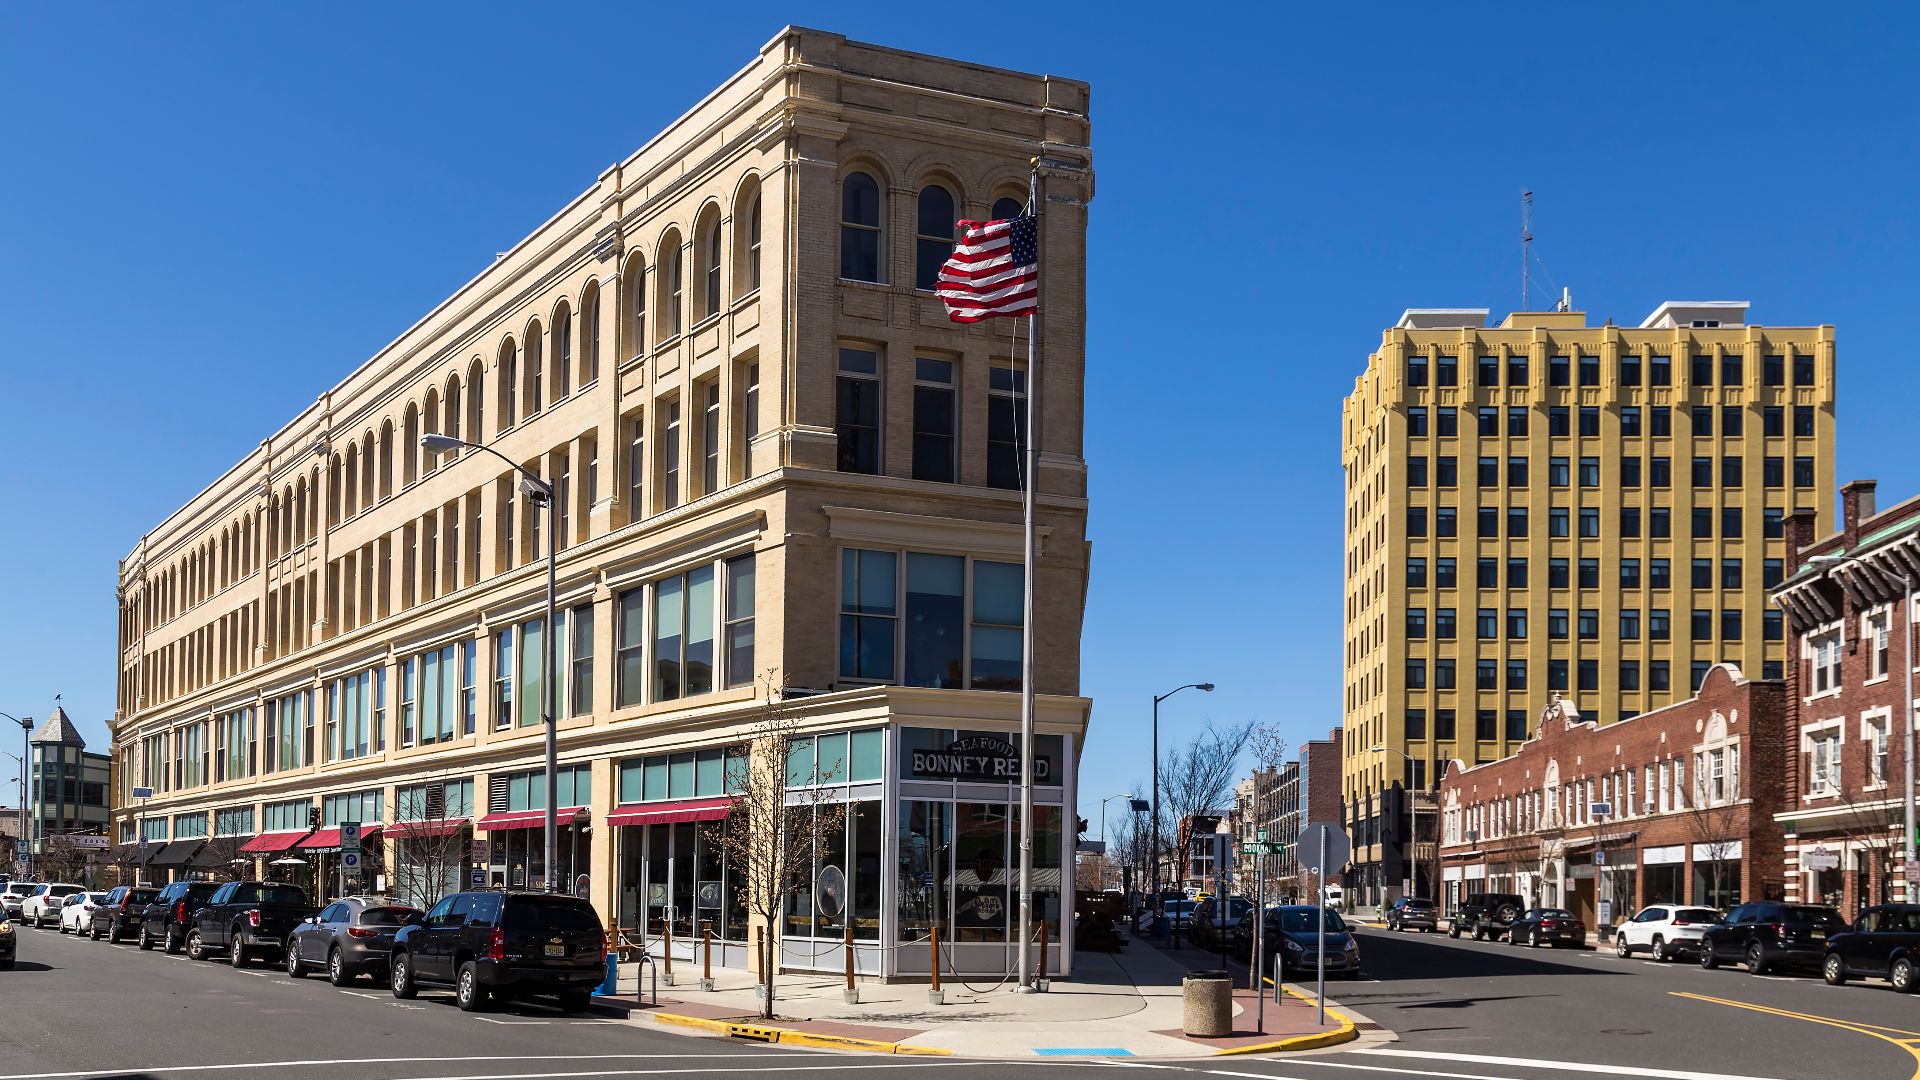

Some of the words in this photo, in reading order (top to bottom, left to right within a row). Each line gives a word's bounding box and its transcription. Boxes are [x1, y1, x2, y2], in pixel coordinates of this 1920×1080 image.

[953, 737, 1014, 757] SEAFOOD
[913, 753, 988, 773] BONNEY
[994, 758, 1048, 777] RED
